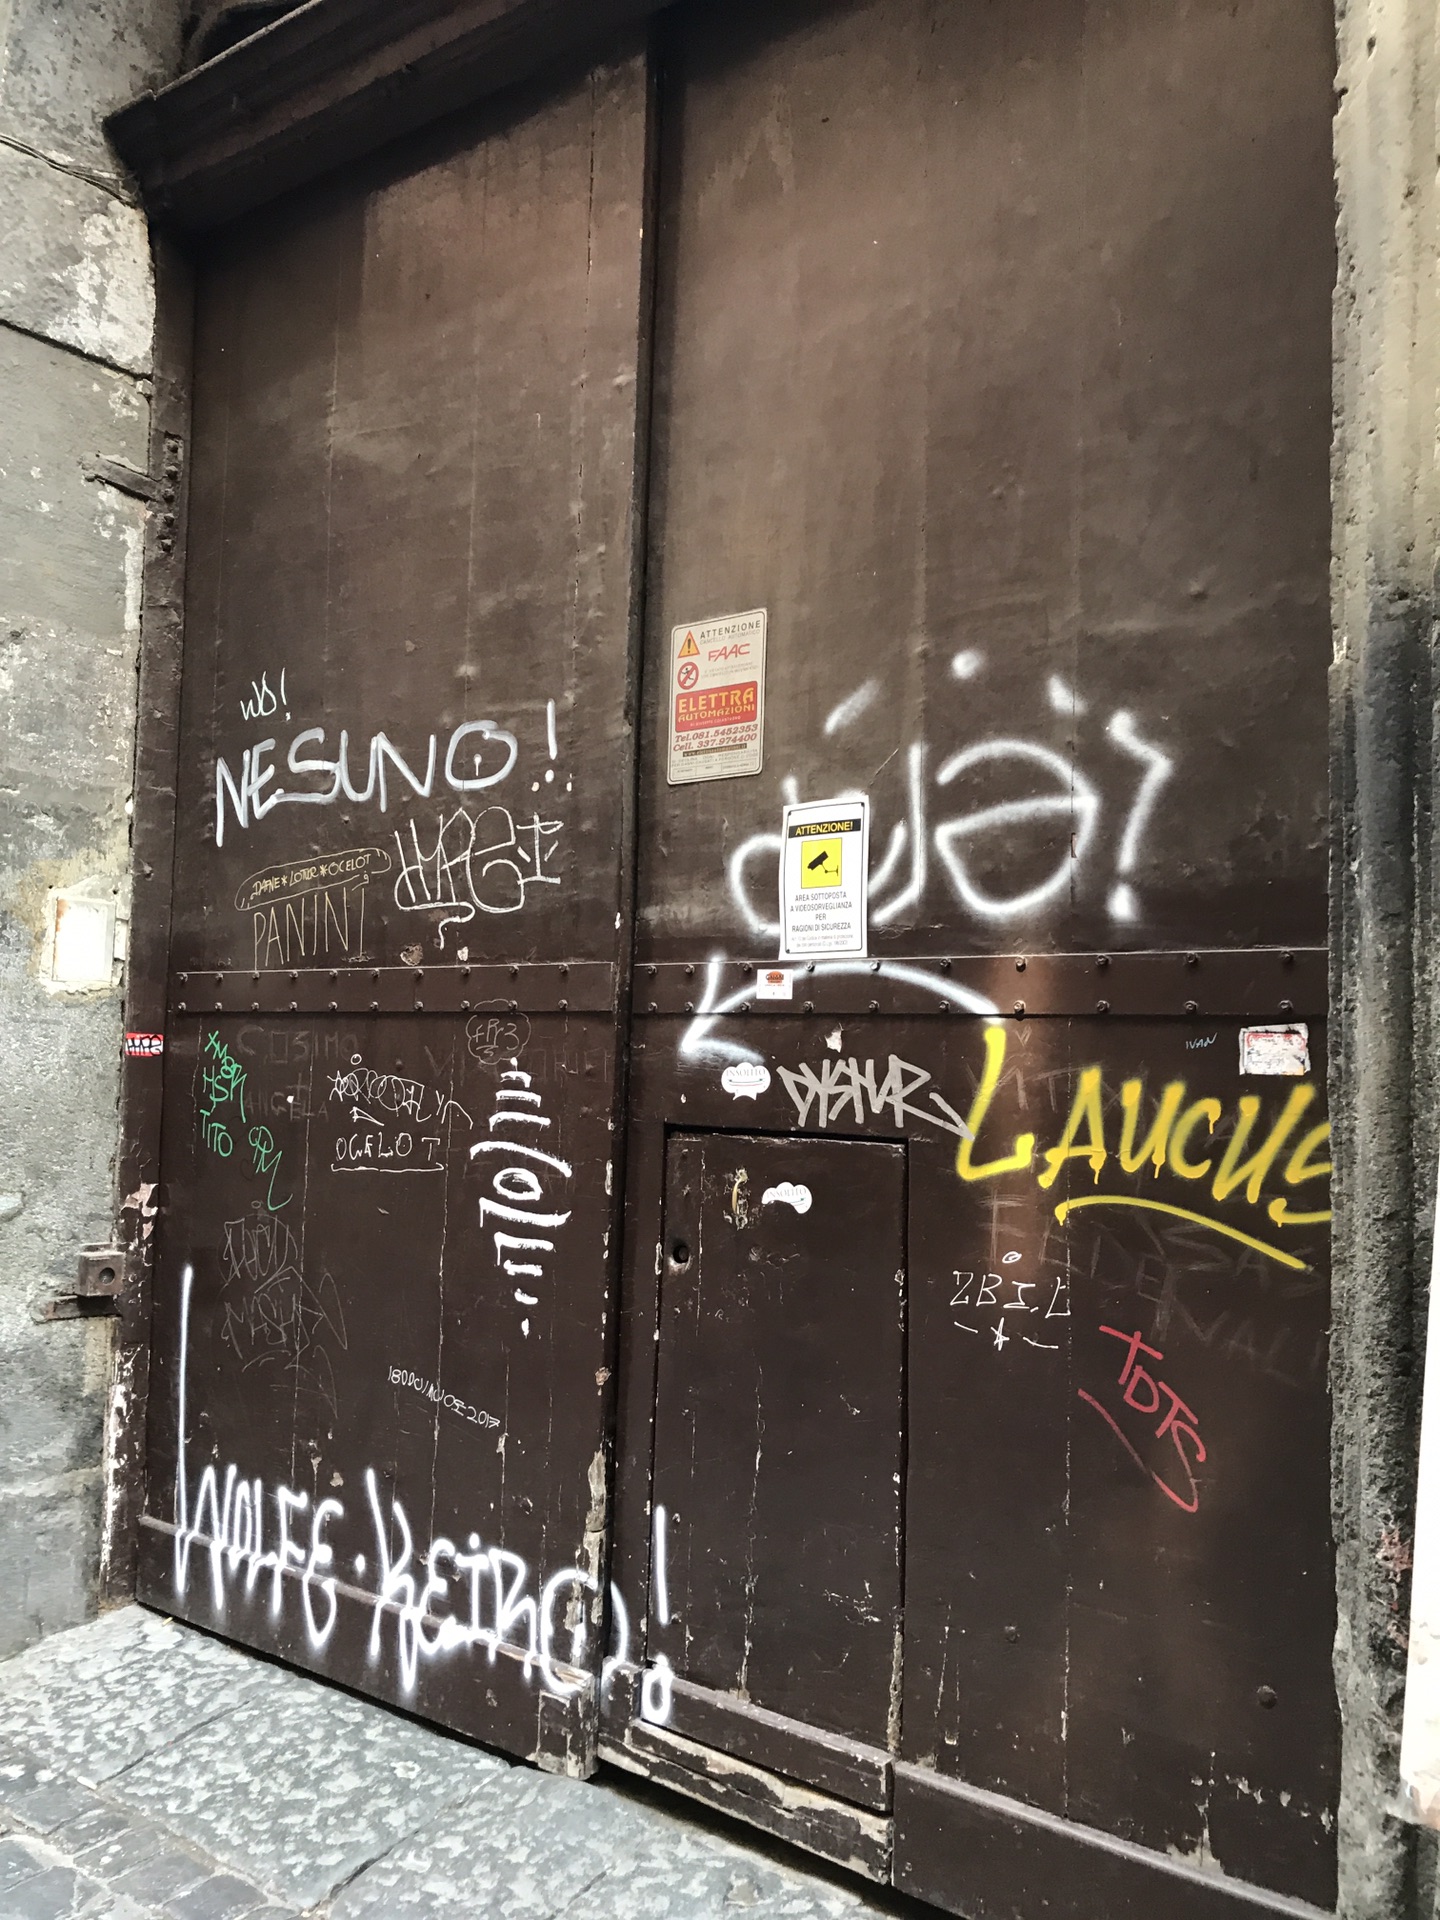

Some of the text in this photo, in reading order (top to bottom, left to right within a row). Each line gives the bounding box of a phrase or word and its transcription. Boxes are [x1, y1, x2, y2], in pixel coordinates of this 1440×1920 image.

[699, 620, 761, 639] ATTENZIONE
[708, 643, 751, 662] FAAC
[678, 687, 755, 714] ELETTRA
[677, 703, 756, 722] AUTOMAZIONI
[697, 733, 758, 749] 337.974400
[796, 821, 853, 836] ATTENZIONE!
[328, 854, 372, 876] OCELOT
[794, 891, 847, 902] AREA SOTTOPOSTA
[795, 901, 853, 912] VIDEOSORVEGLIANZA
[815, 913, 827, 921] PER
[253, 886, 365, 971] PANINI
[791, 922, 852, 932] RAGIONI DI SICUREZZA
[1185, 1032, 1218, 1050] IVAN
[726, 1068, 766, 1078] INSOLITO
[200, 1109, 233, 1157] TITO
